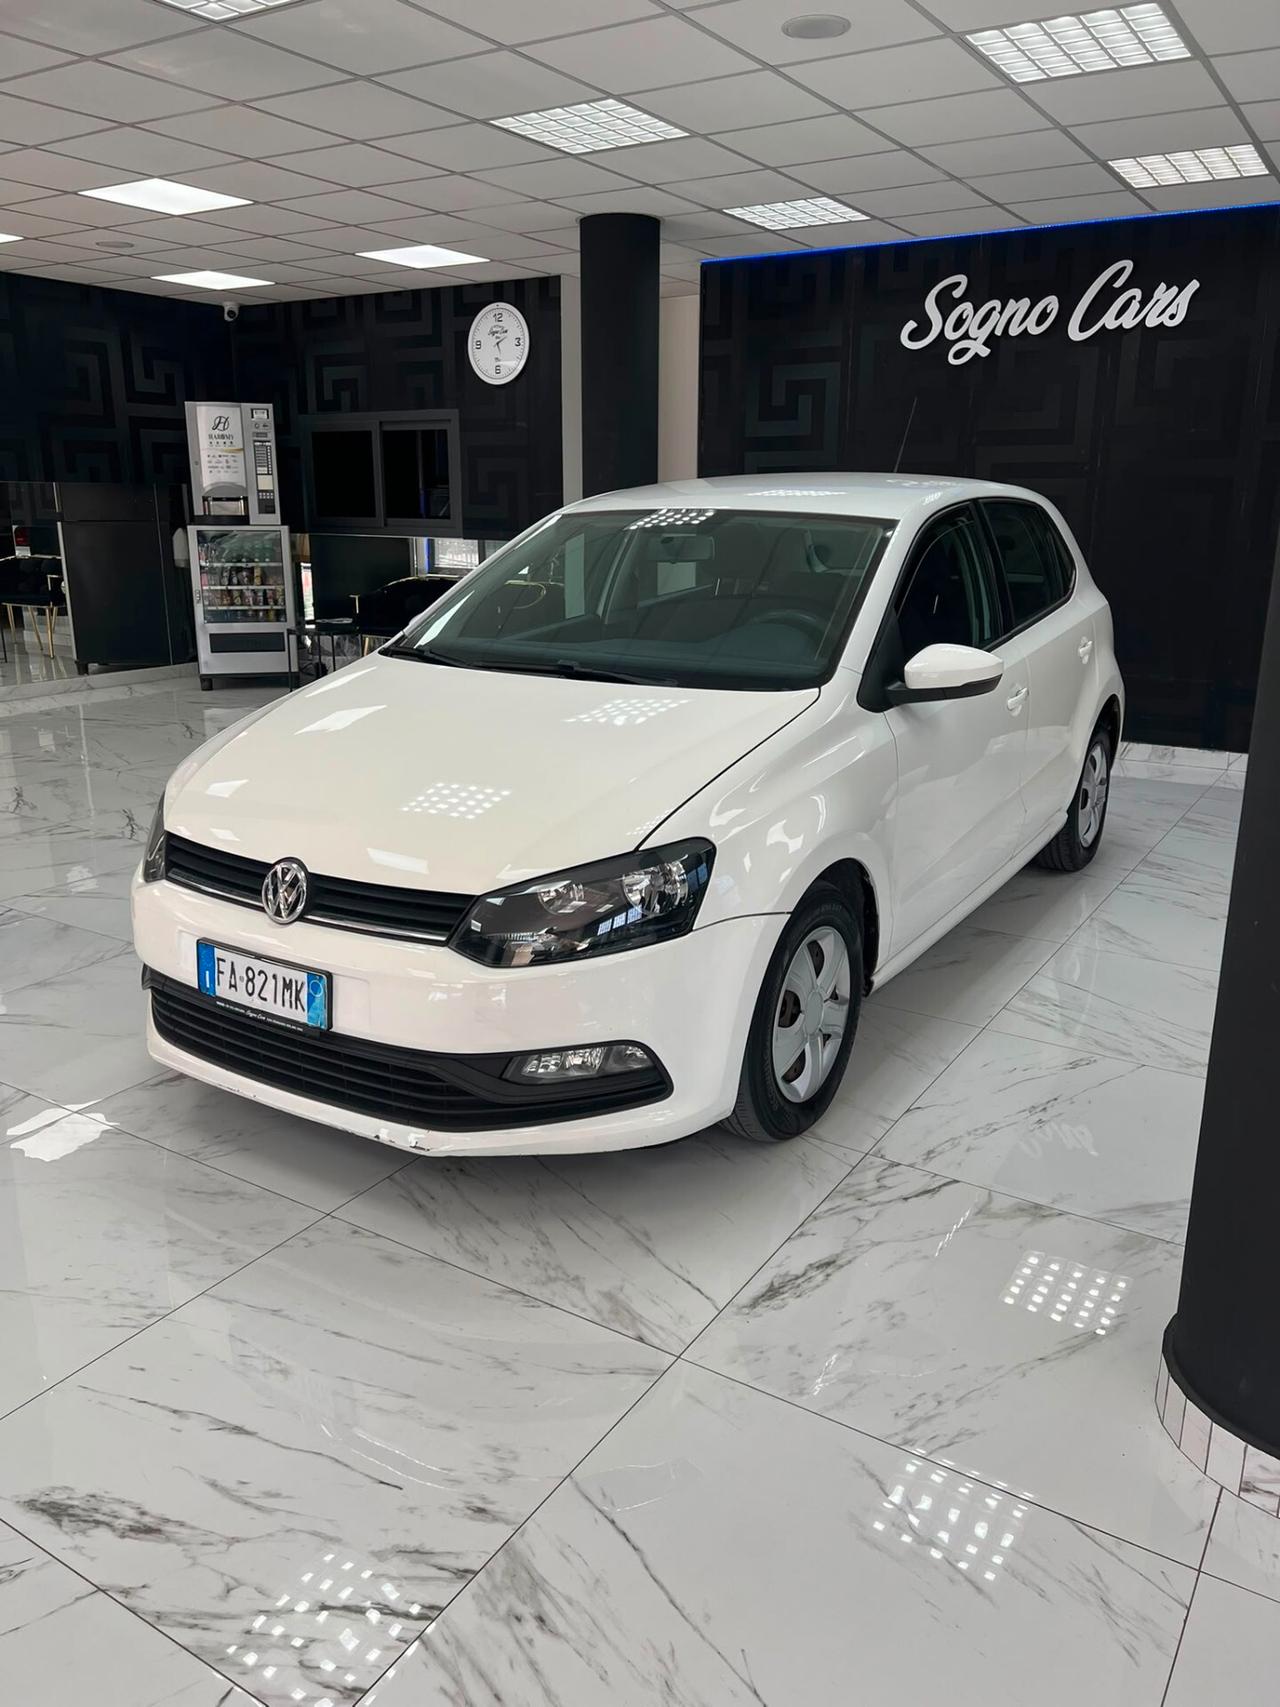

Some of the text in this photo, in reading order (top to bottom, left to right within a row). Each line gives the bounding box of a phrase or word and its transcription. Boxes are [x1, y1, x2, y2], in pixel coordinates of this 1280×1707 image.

[493, 312, 503, 322] 12
[900, 259, 1200, 365] Sogno Cars
[475, 340, 481, 350] 9
[515, 337, 521, 347] 3
[495, 365, 501, 374] 6
